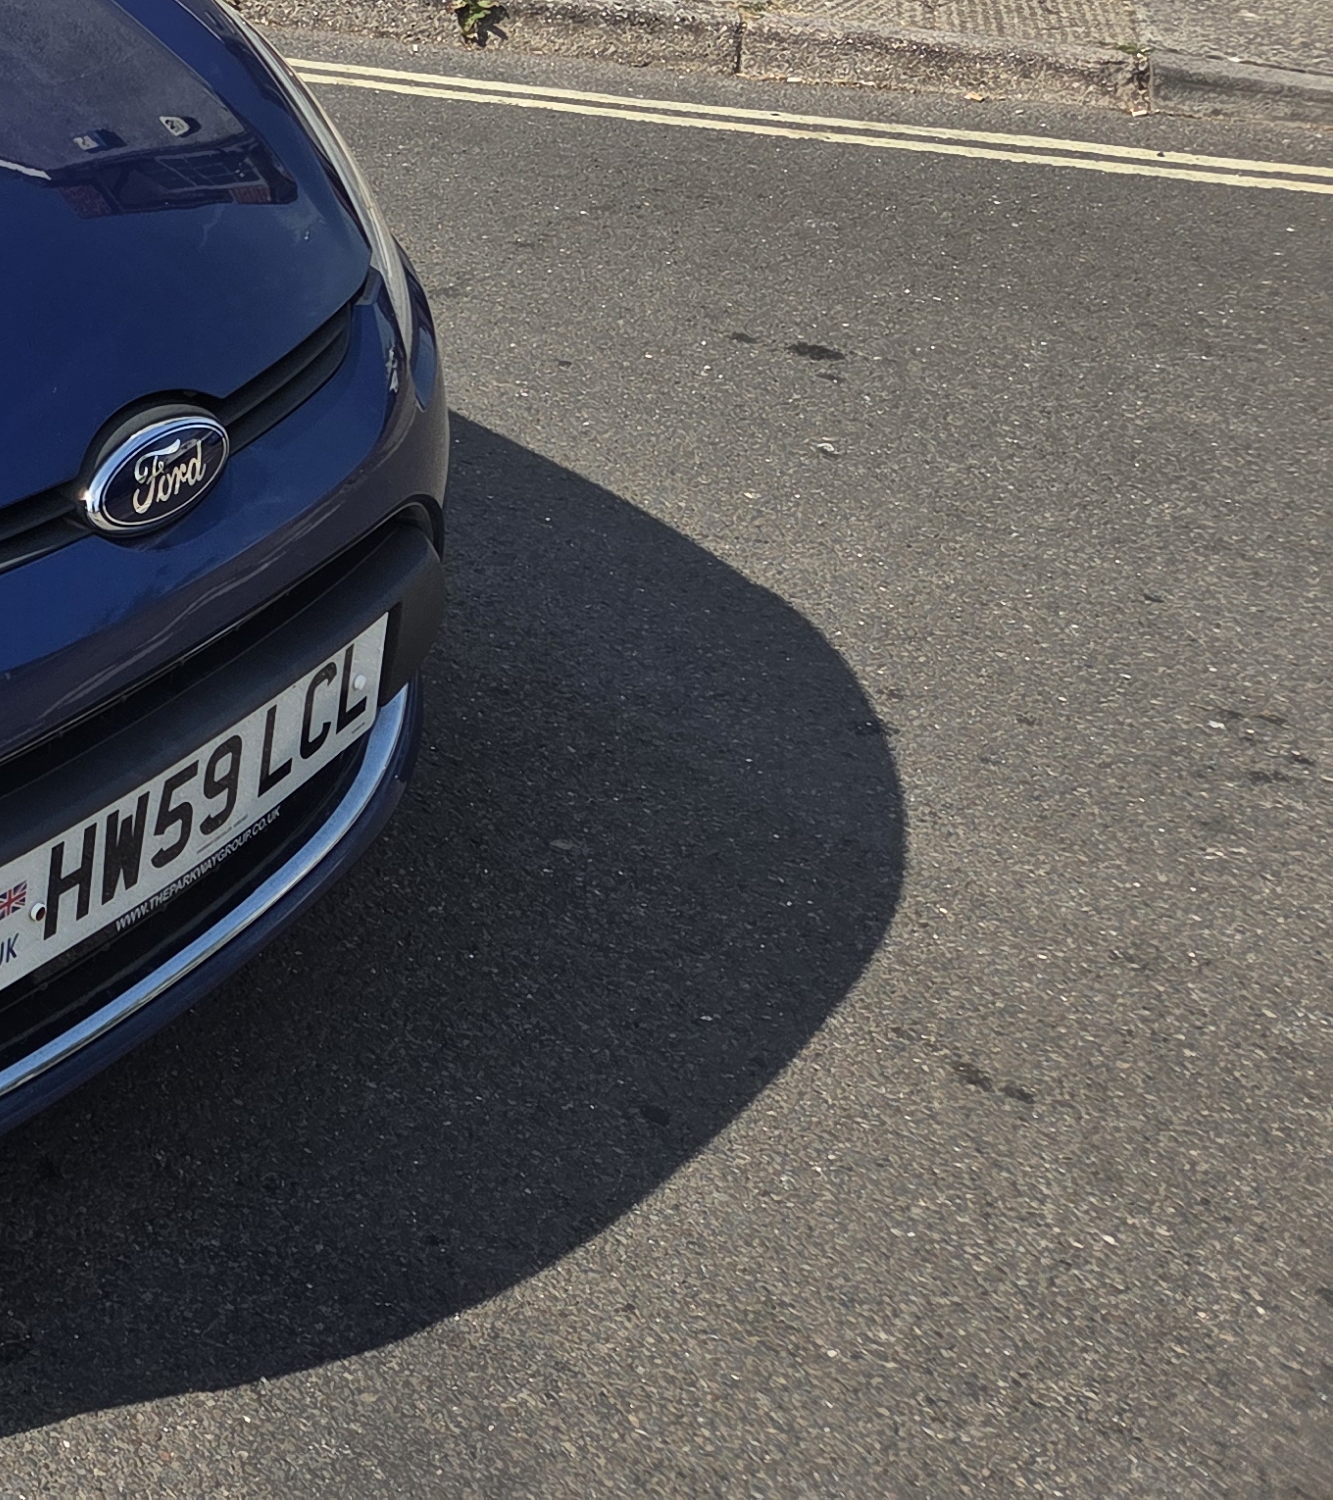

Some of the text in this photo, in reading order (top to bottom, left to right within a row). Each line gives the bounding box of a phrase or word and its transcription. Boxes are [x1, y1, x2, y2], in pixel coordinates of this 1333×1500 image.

[134, 438, 206, 514] Ford
[43, 642, 368, 941] HW59 LCL
[115, 805, 281, 932] WWW.THEPARKWAYGROUP.CO.UK
